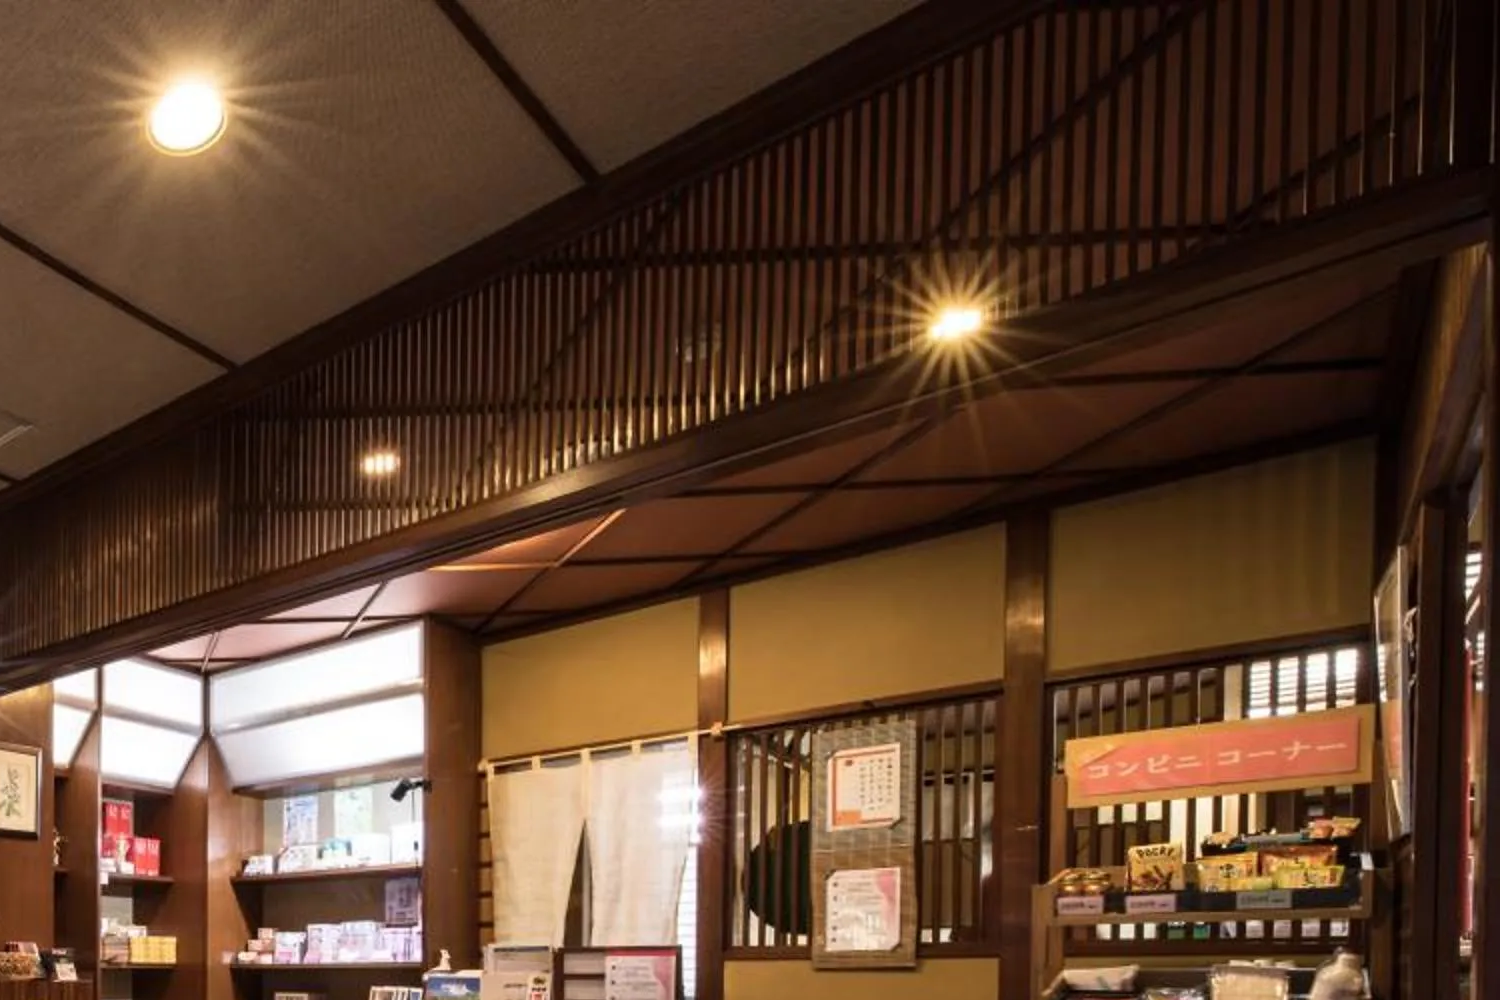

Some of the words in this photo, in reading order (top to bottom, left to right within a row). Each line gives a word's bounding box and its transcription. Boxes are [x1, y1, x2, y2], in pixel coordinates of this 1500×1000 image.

[1086, 753, 1203, 779] コンビニ
[1216, 740, 1348, 767] コーナー
